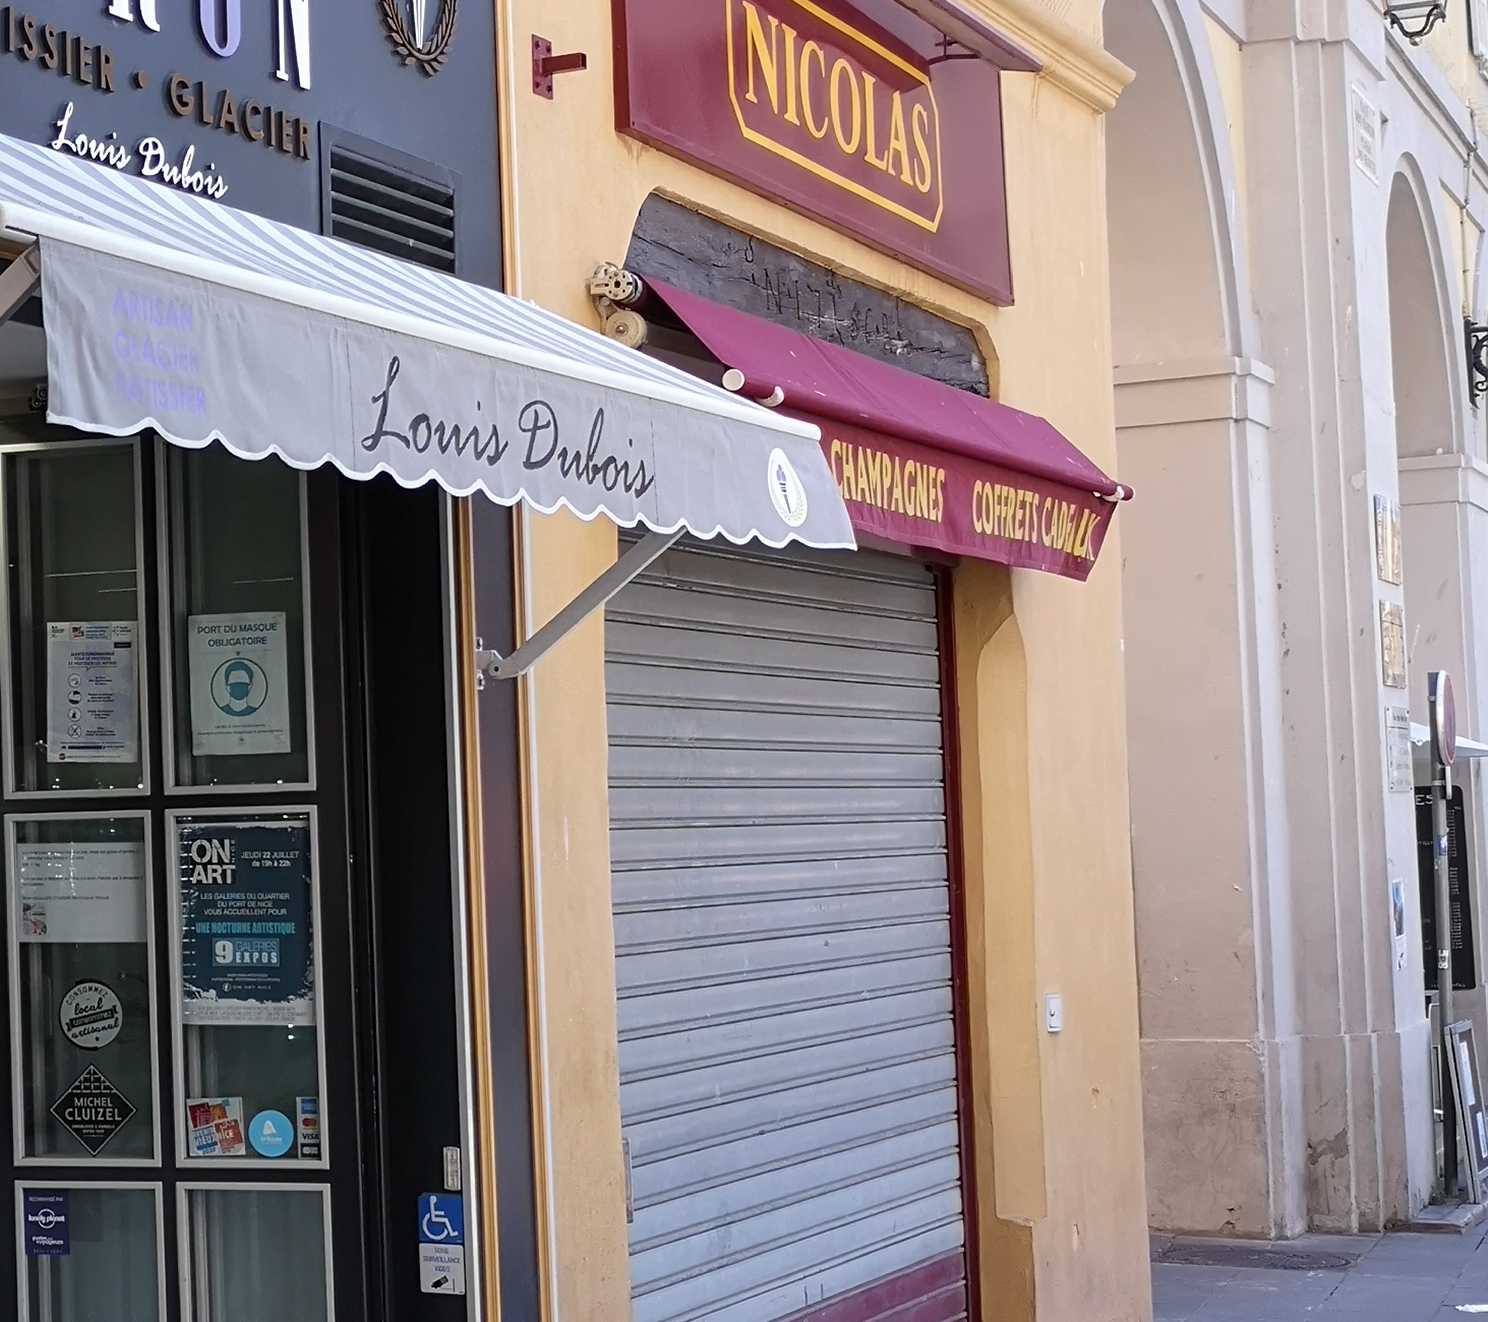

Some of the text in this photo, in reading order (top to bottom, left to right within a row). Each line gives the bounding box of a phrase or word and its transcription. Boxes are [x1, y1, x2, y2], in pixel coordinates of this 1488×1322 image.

[741, 0, 932, 194] NICOLAS
[165, 71, 311, 161] GLACIER
[52, 102, 229, 199] Louis Dubois
[361, 355, 655, 500] Louis Dubois
[829, 438, 946, 524] CHAMPAGNES
[971, 479, 1040, 544] COFFRETS
[197, 622, 278, 634] PORT DU MASQUE
[208, 636, 267, 648] OBLIGATOIRE
[190, 838, 231, 864] ON
[241, 851, 261, 859] JEUDI
[272, 850, 300, 859] JUILLET
[191, 864, 236, 885] ART
[256, 892, 290, 900] QUARTIER
[195, 922, 295, 935] UNE NOCTURNE ARTISTIQUE
[214, 940, 277, 964] 9 GALERIES
[236, 952, 277, 963] EXPOS
[66, 986, 109, 1005] CONSOMMEZ
[75, 997, 103, 1015] local
[71, 1017, 119, 1039] artisanal
[74, 1097, 113, 1107] MICHEL
[65, 1108, 122, 1120] CLUIZEL
[422, 1255, 461, 1264] SURVEILLANCE
[434, 1247, 449, 1255] SOUS
